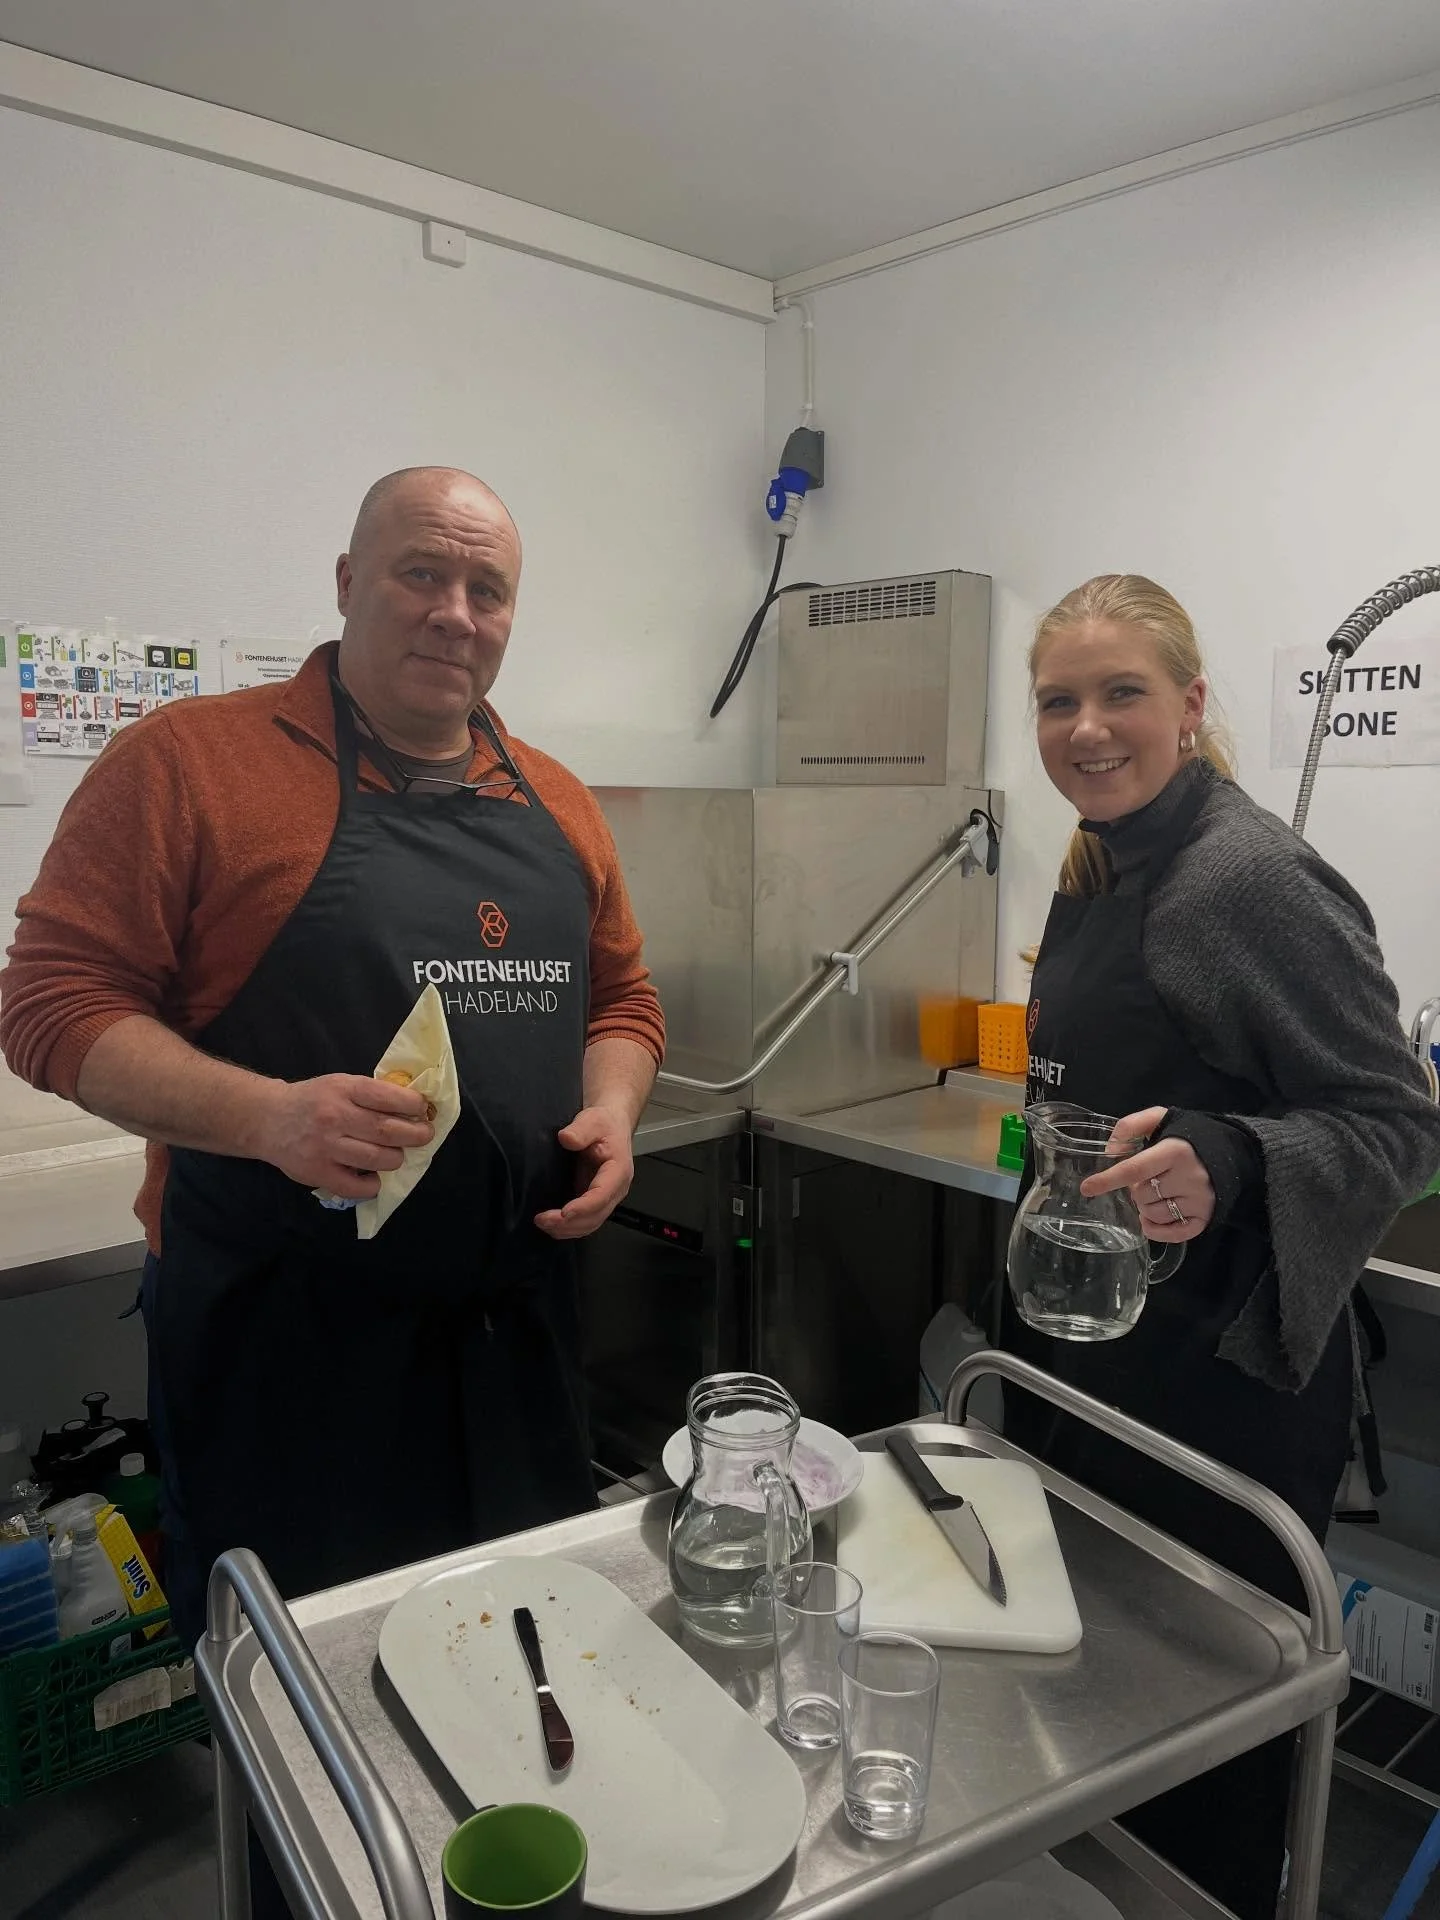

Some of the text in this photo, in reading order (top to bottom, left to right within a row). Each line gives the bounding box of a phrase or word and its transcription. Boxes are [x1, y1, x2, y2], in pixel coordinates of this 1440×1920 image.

[244, 654, 287, 663] FONTENEHUSET
[412, 959, 572, 984] FONTENEHUSET
[445, 990, 558, 1015] HADELAND
[121, 1553, 151, 1599] Svint
